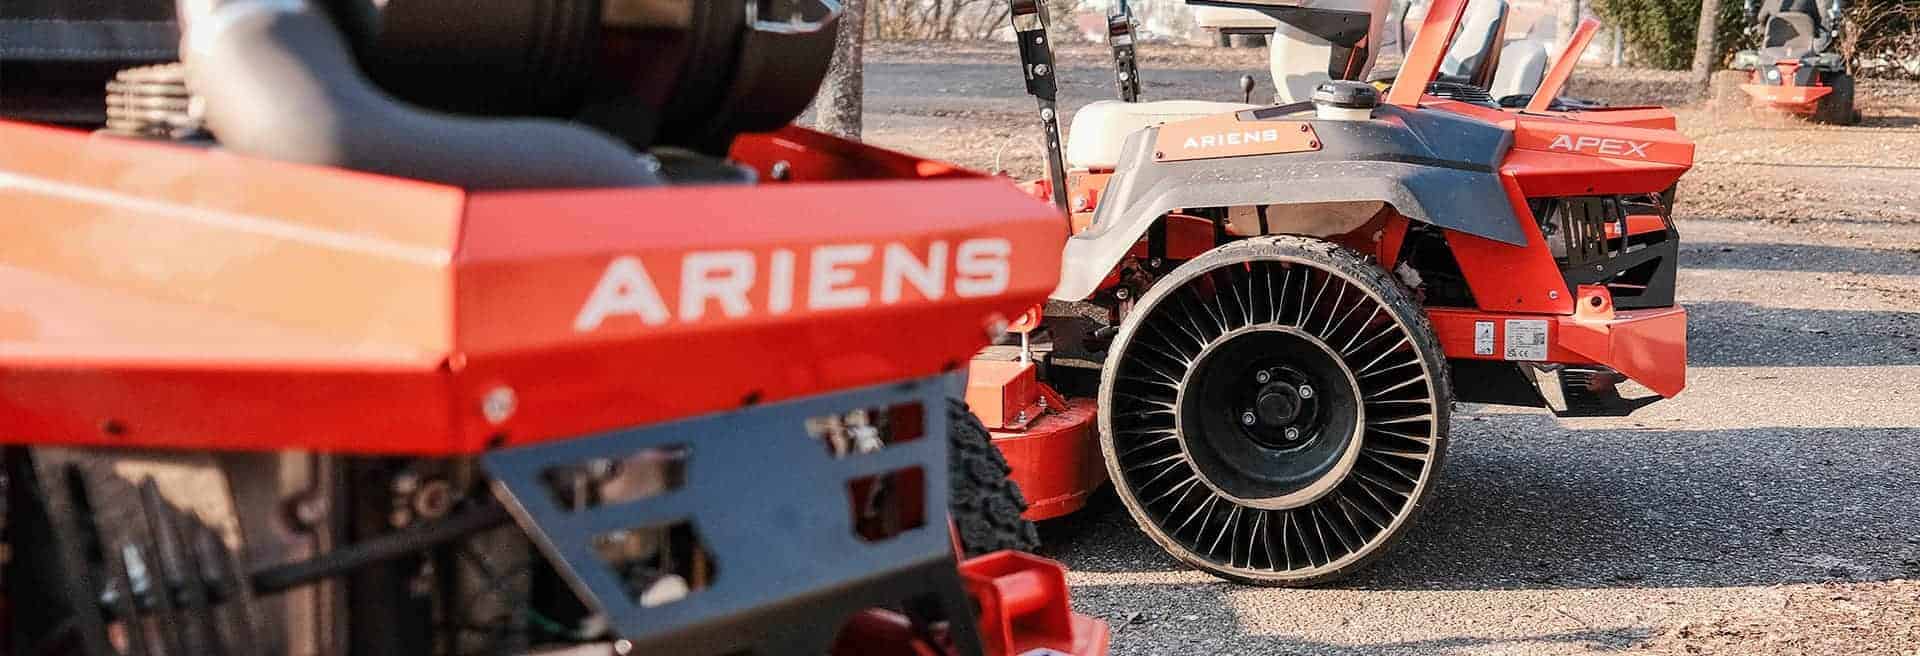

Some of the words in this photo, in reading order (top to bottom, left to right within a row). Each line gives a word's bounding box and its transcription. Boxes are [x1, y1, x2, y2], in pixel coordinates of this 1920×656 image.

[1183, 129, 1279, 149] ARIENS
[1549, 134, 1653, 157] APEX
[575, 238, 1012, 332] ARIENS
